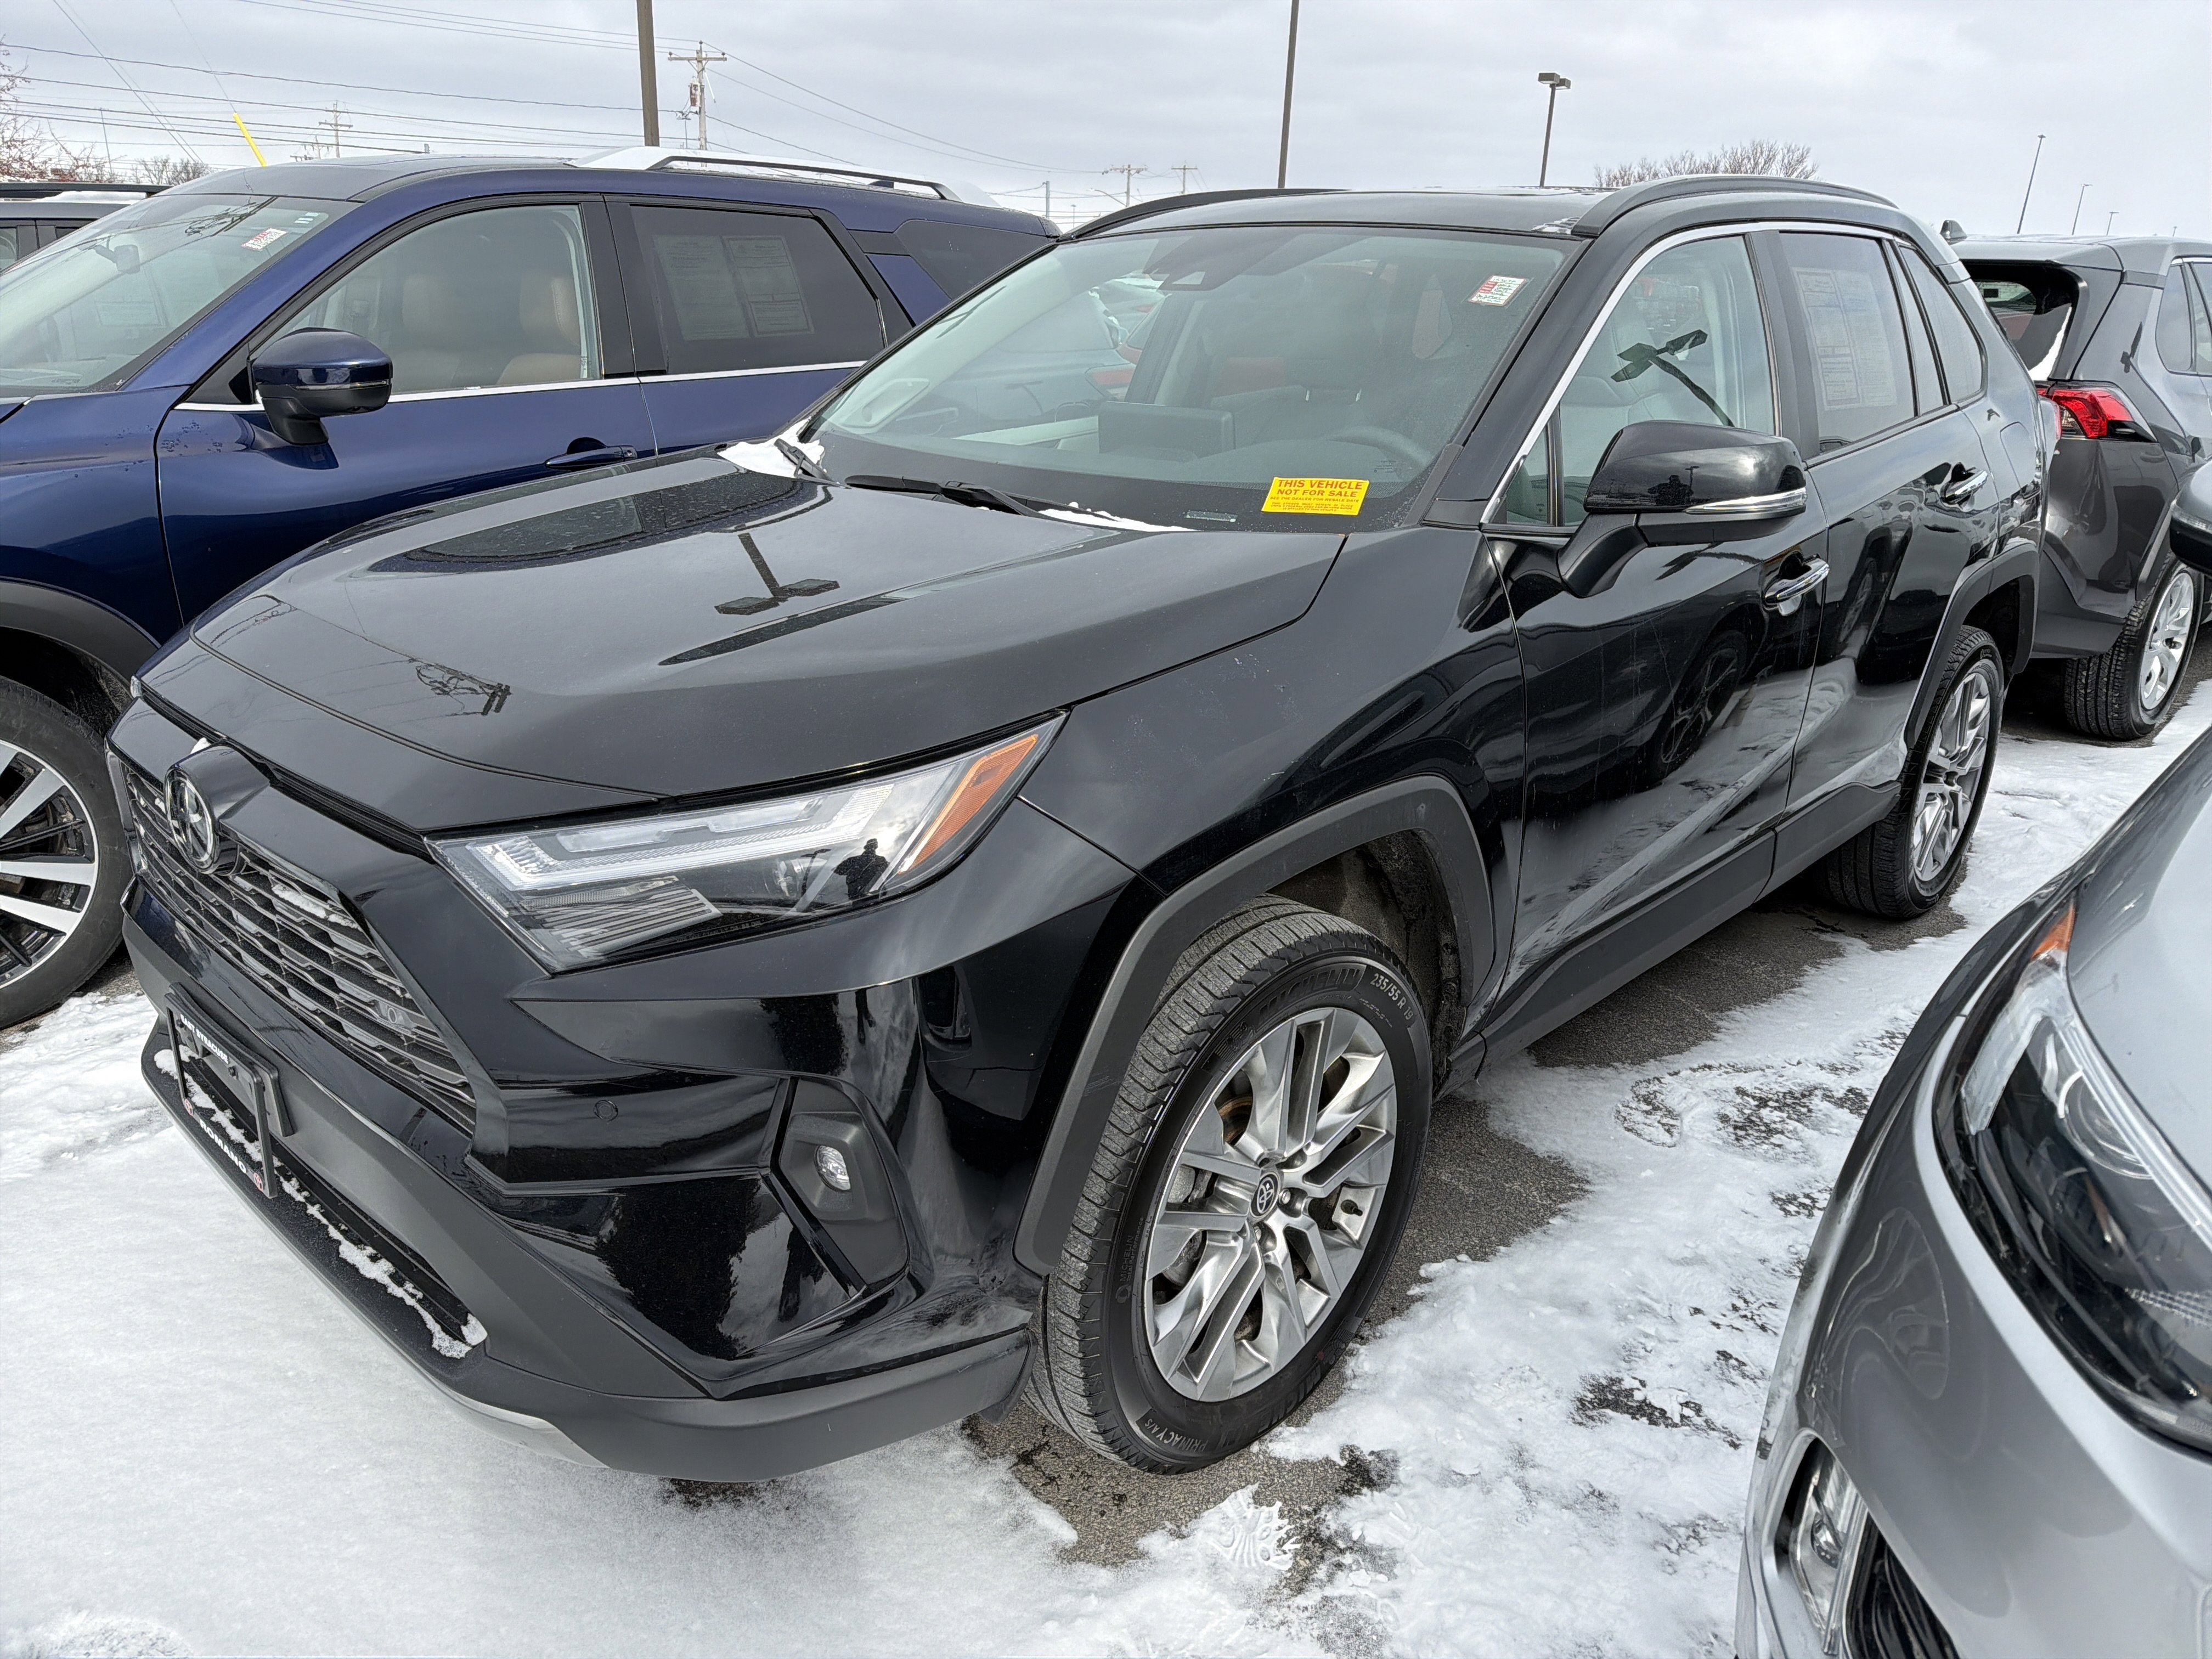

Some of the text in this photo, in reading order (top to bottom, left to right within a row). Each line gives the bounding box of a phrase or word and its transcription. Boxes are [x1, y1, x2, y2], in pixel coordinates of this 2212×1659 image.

[1278, 479, 1364, 490] THIS VEHICLE
[1370, 973, 1414, 1020] 235/55 R 19
[180, 1013, 229, 1064] EAST SYRACUSE
[199, 1118, 246, 1173] ROMANO
[1120, 1235, 1133, 1282] MICHELIN
[1144, 1419, 1209, 1452] PRIMACY A/S
